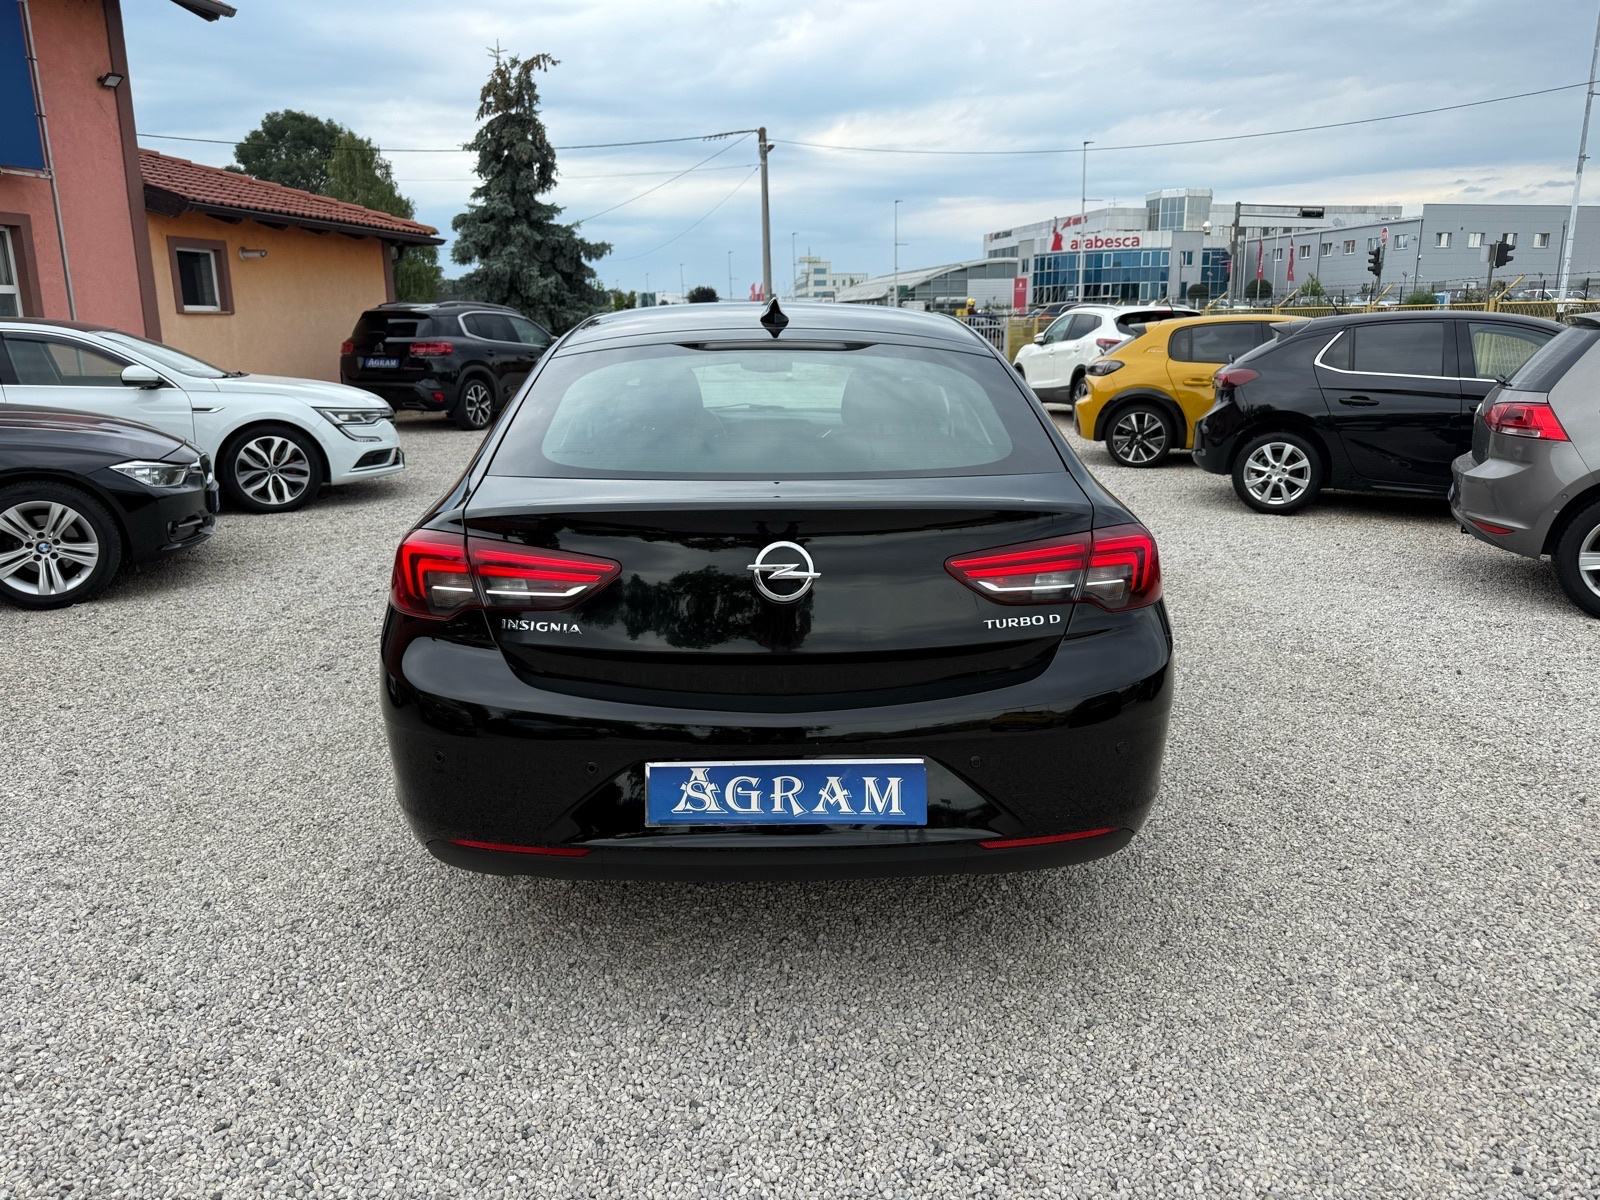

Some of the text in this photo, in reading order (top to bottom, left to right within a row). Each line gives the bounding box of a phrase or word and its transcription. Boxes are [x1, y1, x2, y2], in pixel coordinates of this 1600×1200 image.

[1070, 235, 1140, 250] arabesca
[501, 618, 582, 634] INSIGNIA
[983, 614, 1061, 629] TURBO D
